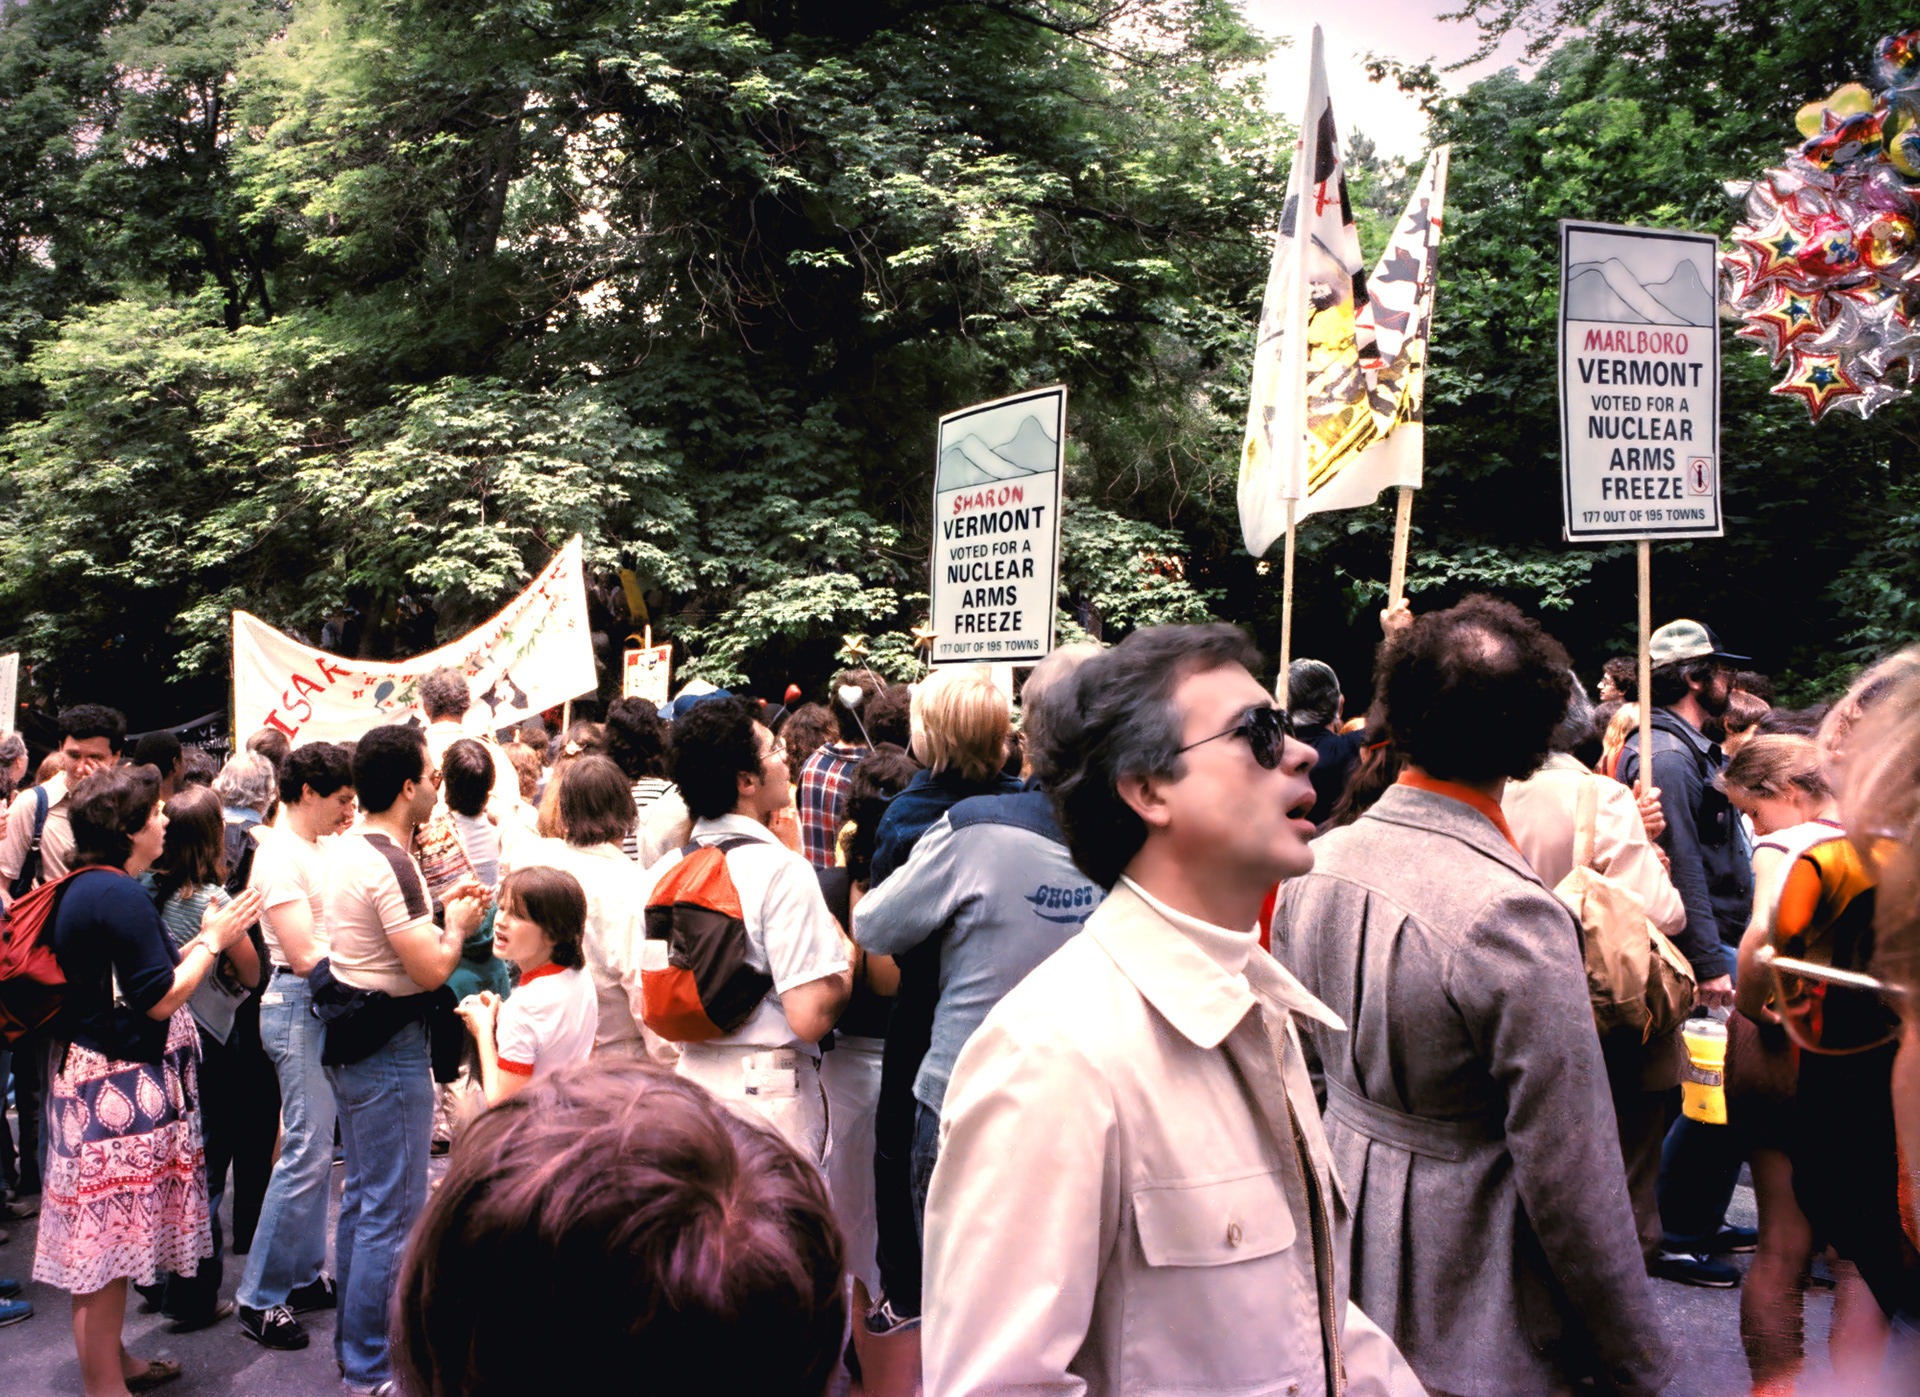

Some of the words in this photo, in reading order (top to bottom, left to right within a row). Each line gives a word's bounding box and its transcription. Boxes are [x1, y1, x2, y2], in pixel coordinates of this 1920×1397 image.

[1584, 328, 1688, 355] MARLBORO
[1578, 358, 1703, 387] VERMONT
[1591, 395, 1641, 411] VOTED
[1647, 397, 1674, 412] FOR
[1679, 398, 1689, 412] A
[1589, 415, 1693, 441] NUCLEAR
[1609, 447, 1675, 471] ARMS
[953, 484, 1024, 515] SHARON
[1602, 477, 1683, 500] FREEZE
[944, 506, 1045, 540] VERMONT
[1583, 511, 1600, 523] 177
[1604, 510, 1626, 522] OUT
[1629, 510, 1642, 522] OF
[1645, 509, 1663, 521] 195
[1667, 508, 1705, 521] TOWNS
[950, 544, 988, 560] VOTED
[993, 540, 1017, 556] FOR
[1022, 539, 1031, 552] A
[948, 558, 1034, 583] NUCLEAR
[962, 585, 1017, 609] ARMS
[955, 611, 1022, 634] FREEZE
[940, 643, 952, 654] 177
[954, 642, 971, 653] OUT
[974, 641, 984, 652] OF
[987, 641, 1002, 651] 195
[1005, 639, 1039, 651] TOWNS
[1036, 885, 1093, 908] GHOST
